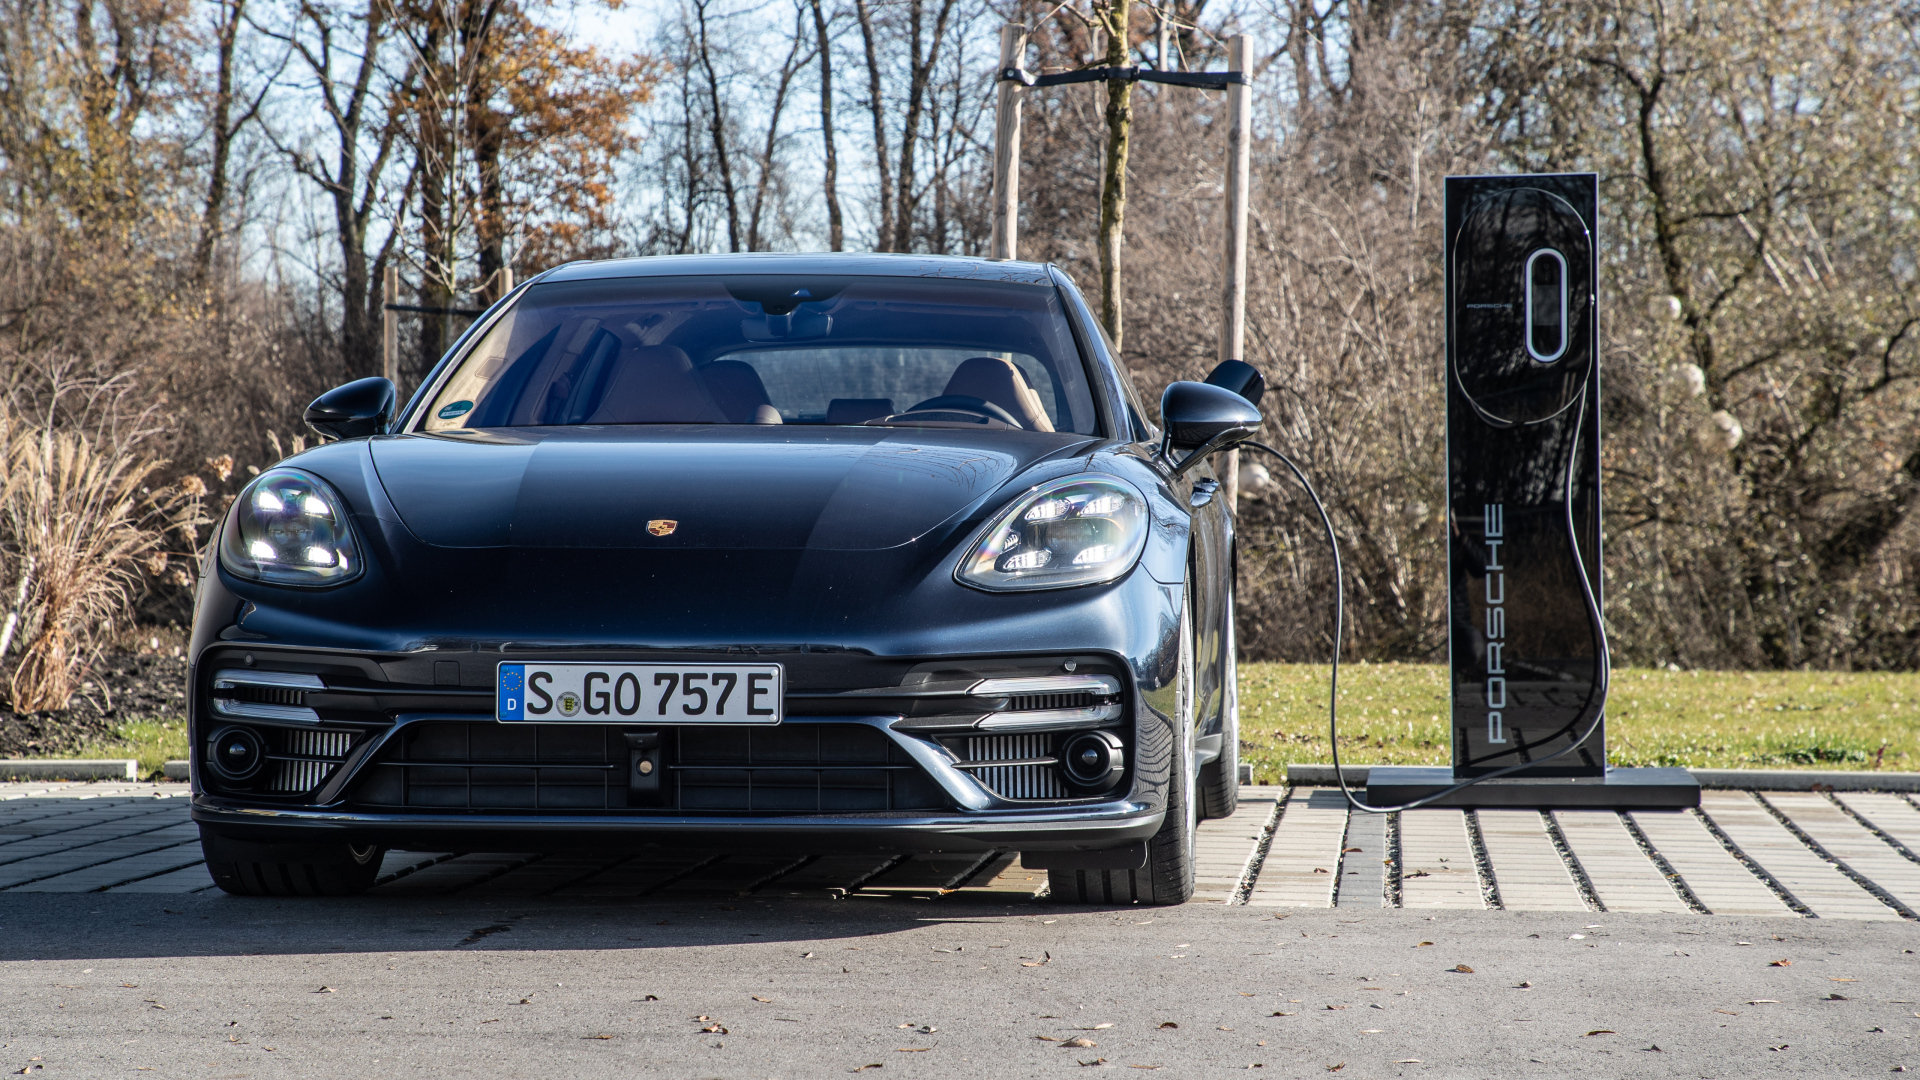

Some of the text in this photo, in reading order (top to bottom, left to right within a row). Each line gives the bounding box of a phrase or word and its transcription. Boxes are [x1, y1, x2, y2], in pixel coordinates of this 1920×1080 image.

[1484, 503, 1507, 743] PORSCHE
[507, 698, 517, 710] D
[526, 671, 774, 716] S GO 757 E
